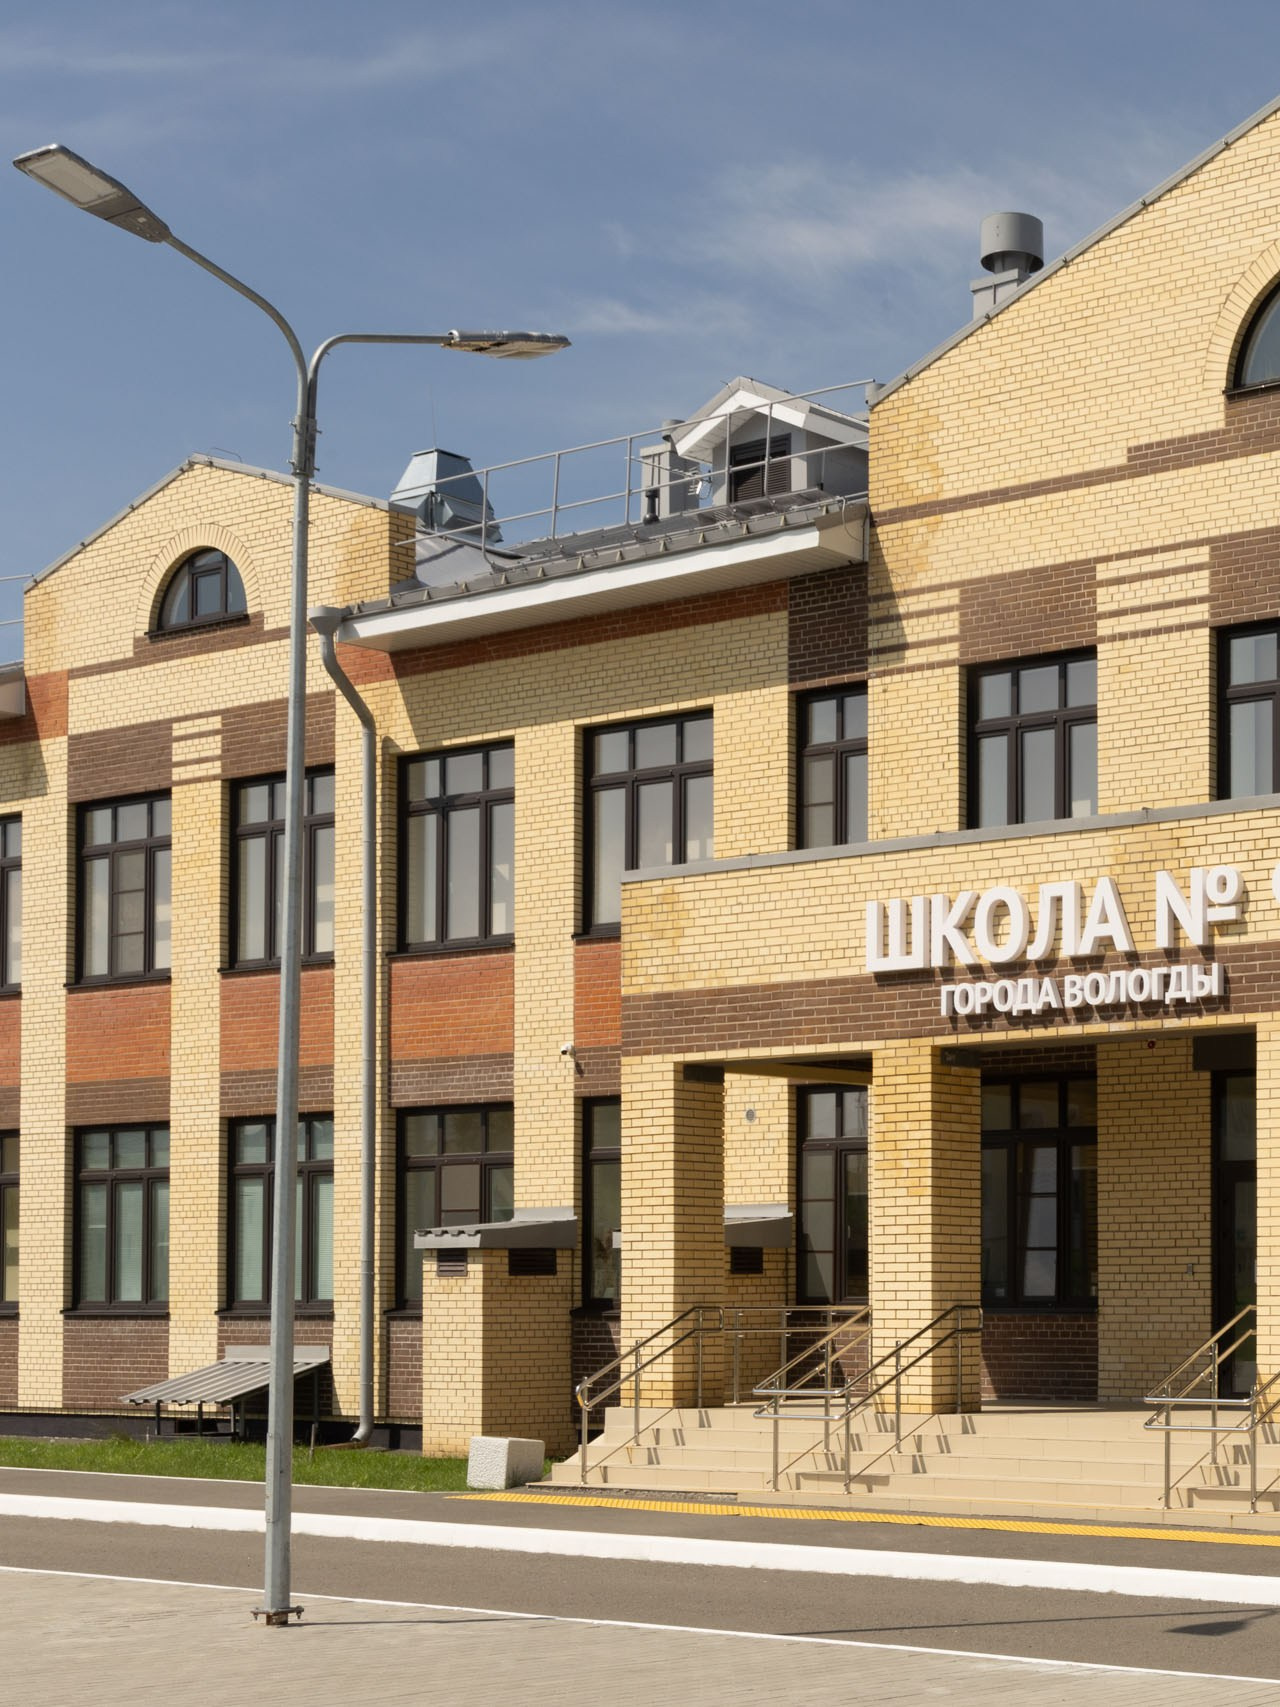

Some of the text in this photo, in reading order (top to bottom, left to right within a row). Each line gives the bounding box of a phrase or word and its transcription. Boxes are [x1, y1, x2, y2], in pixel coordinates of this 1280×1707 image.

[865, 876, 1136, 972] ШКОЛА
[1155, 865, 1244, 949] №
[940, 962, 1225, 1017] ГОРОДА ВОЛОГДЫ
